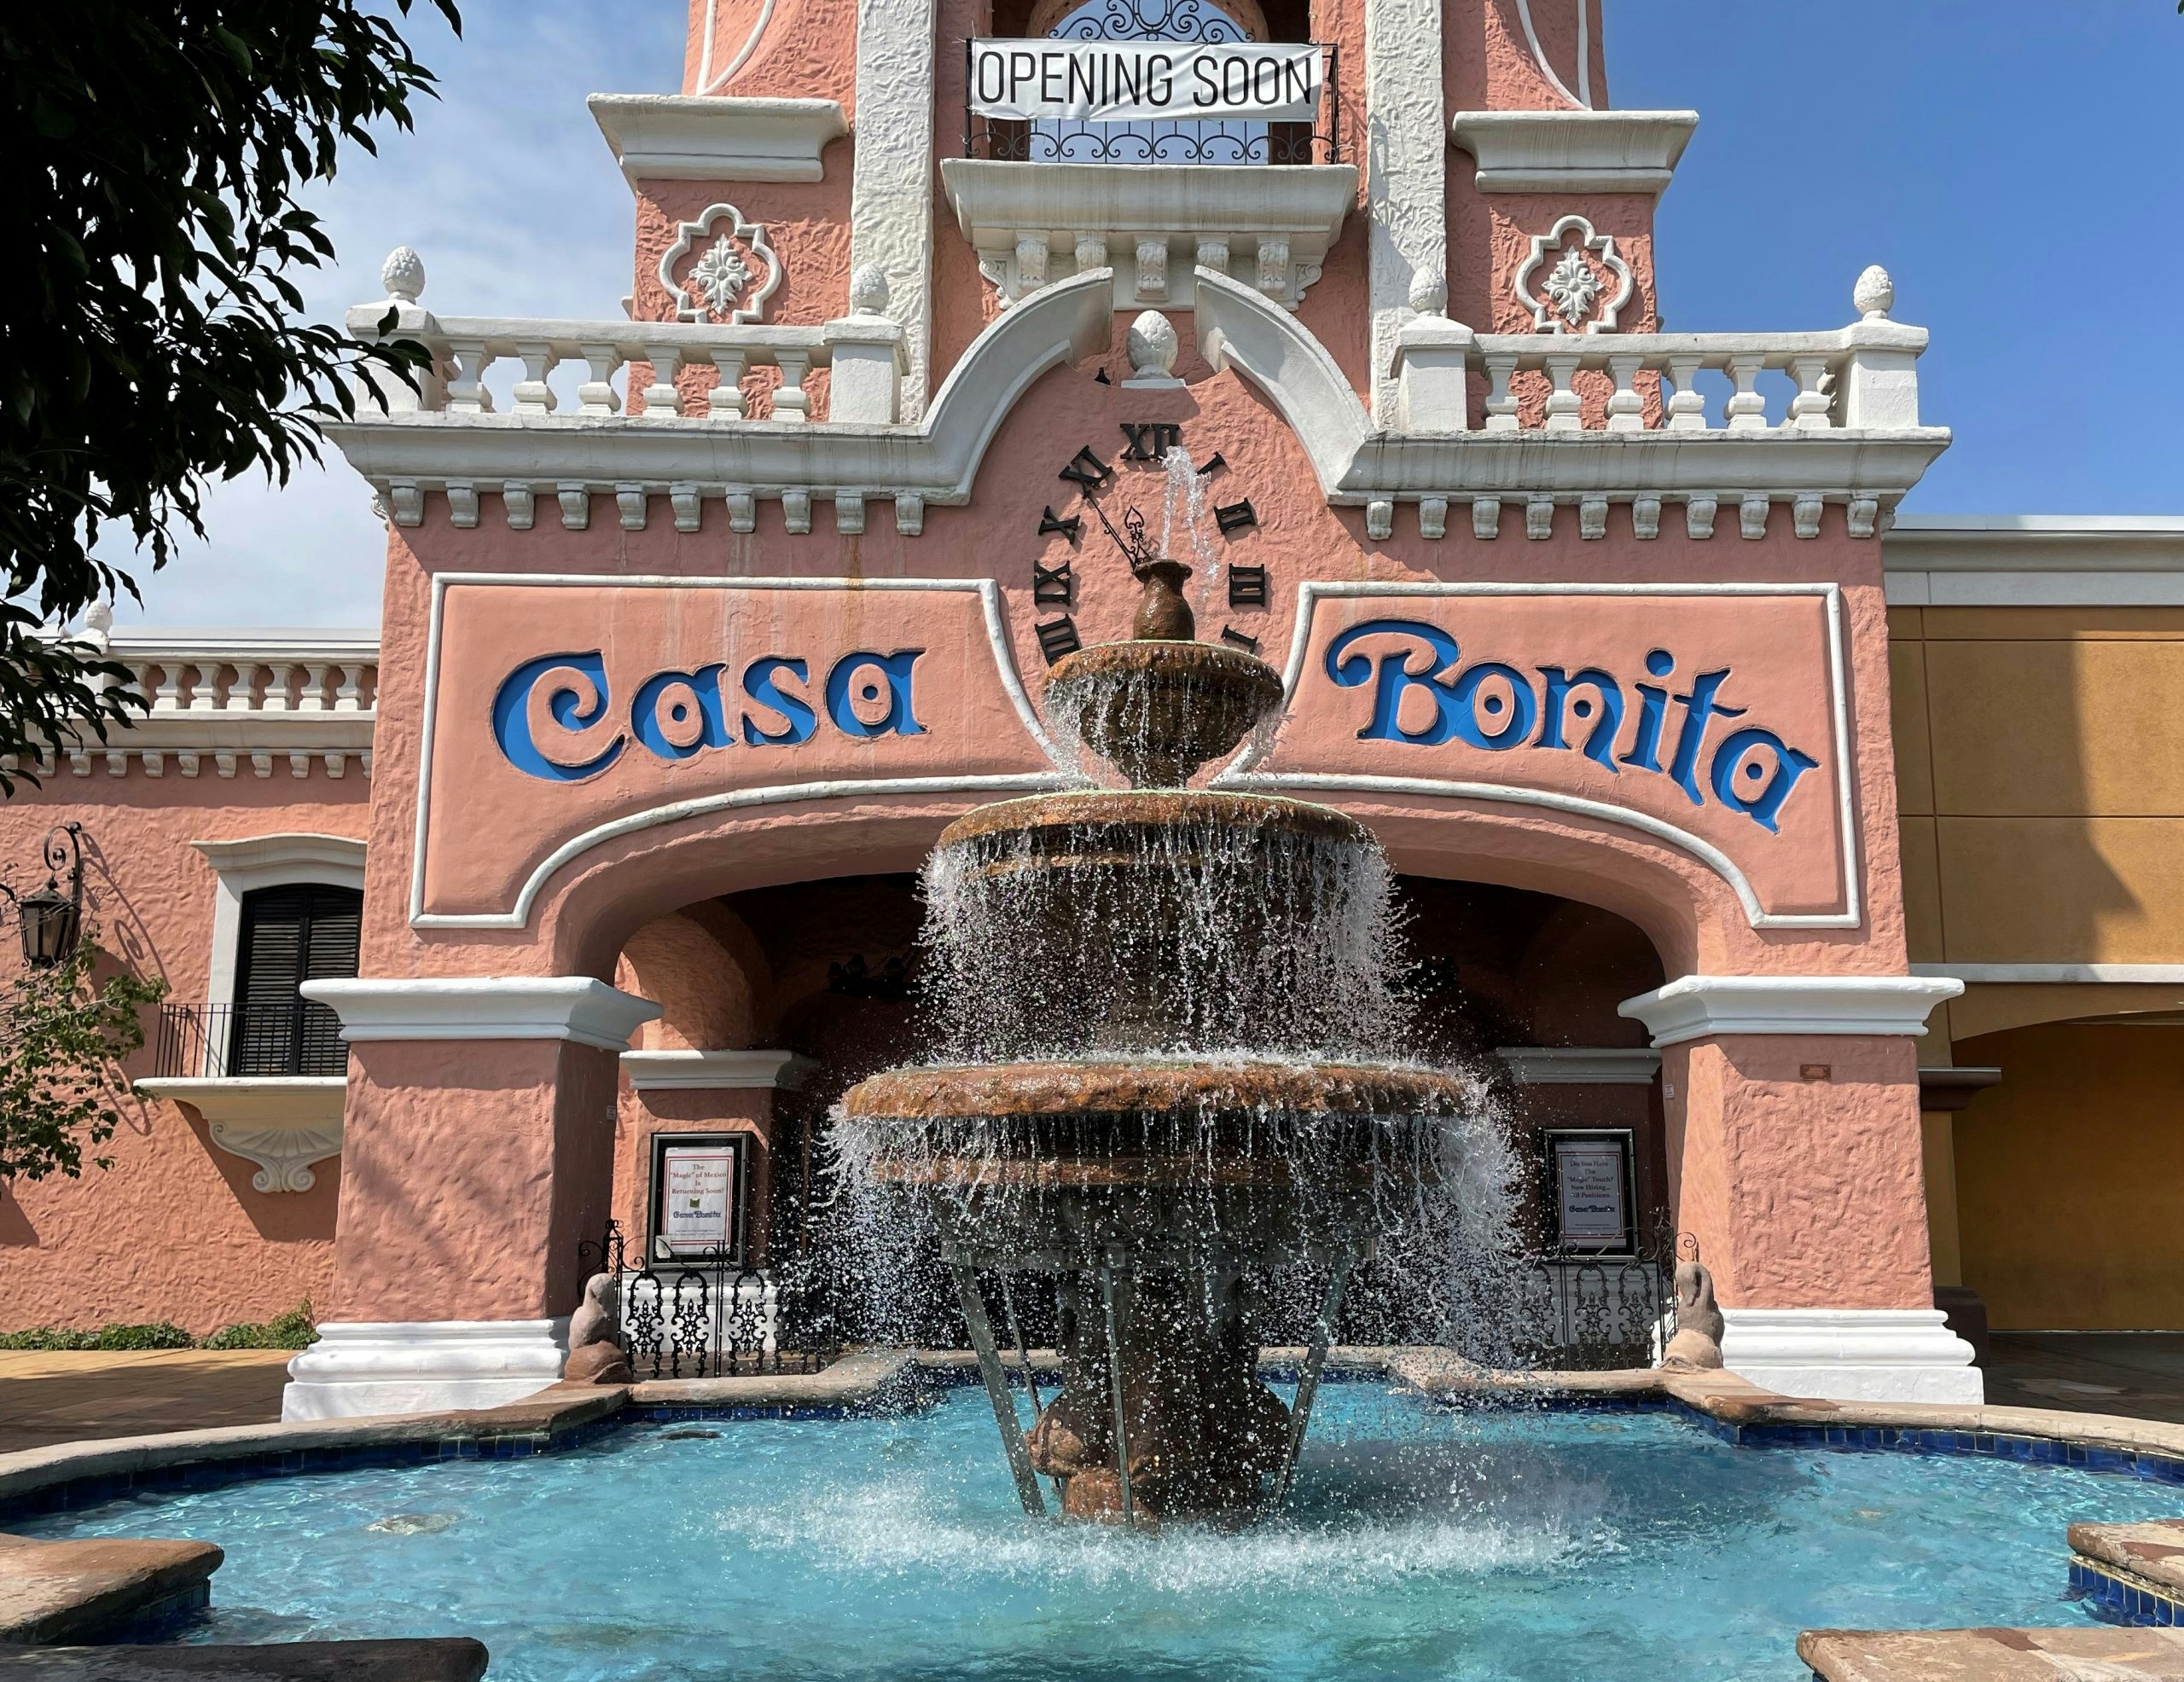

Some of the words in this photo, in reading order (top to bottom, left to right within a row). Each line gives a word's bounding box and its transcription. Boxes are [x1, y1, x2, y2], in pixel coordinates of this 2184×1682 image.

[978, 50, 1172, 107] OPENING
[1193, 55, 1312, 107] SOON
[1058, 445, 1112, 499] XI
[1038, 506, 1081, 544] X
[1213, 497, 1257, 535] II
[1228, 563, 1265, 606] III
[491, 648, 932, 782] Casa
[1325, 619, 1821, 833] Bonita
[694, 1209, 722, 1219] Bonita
